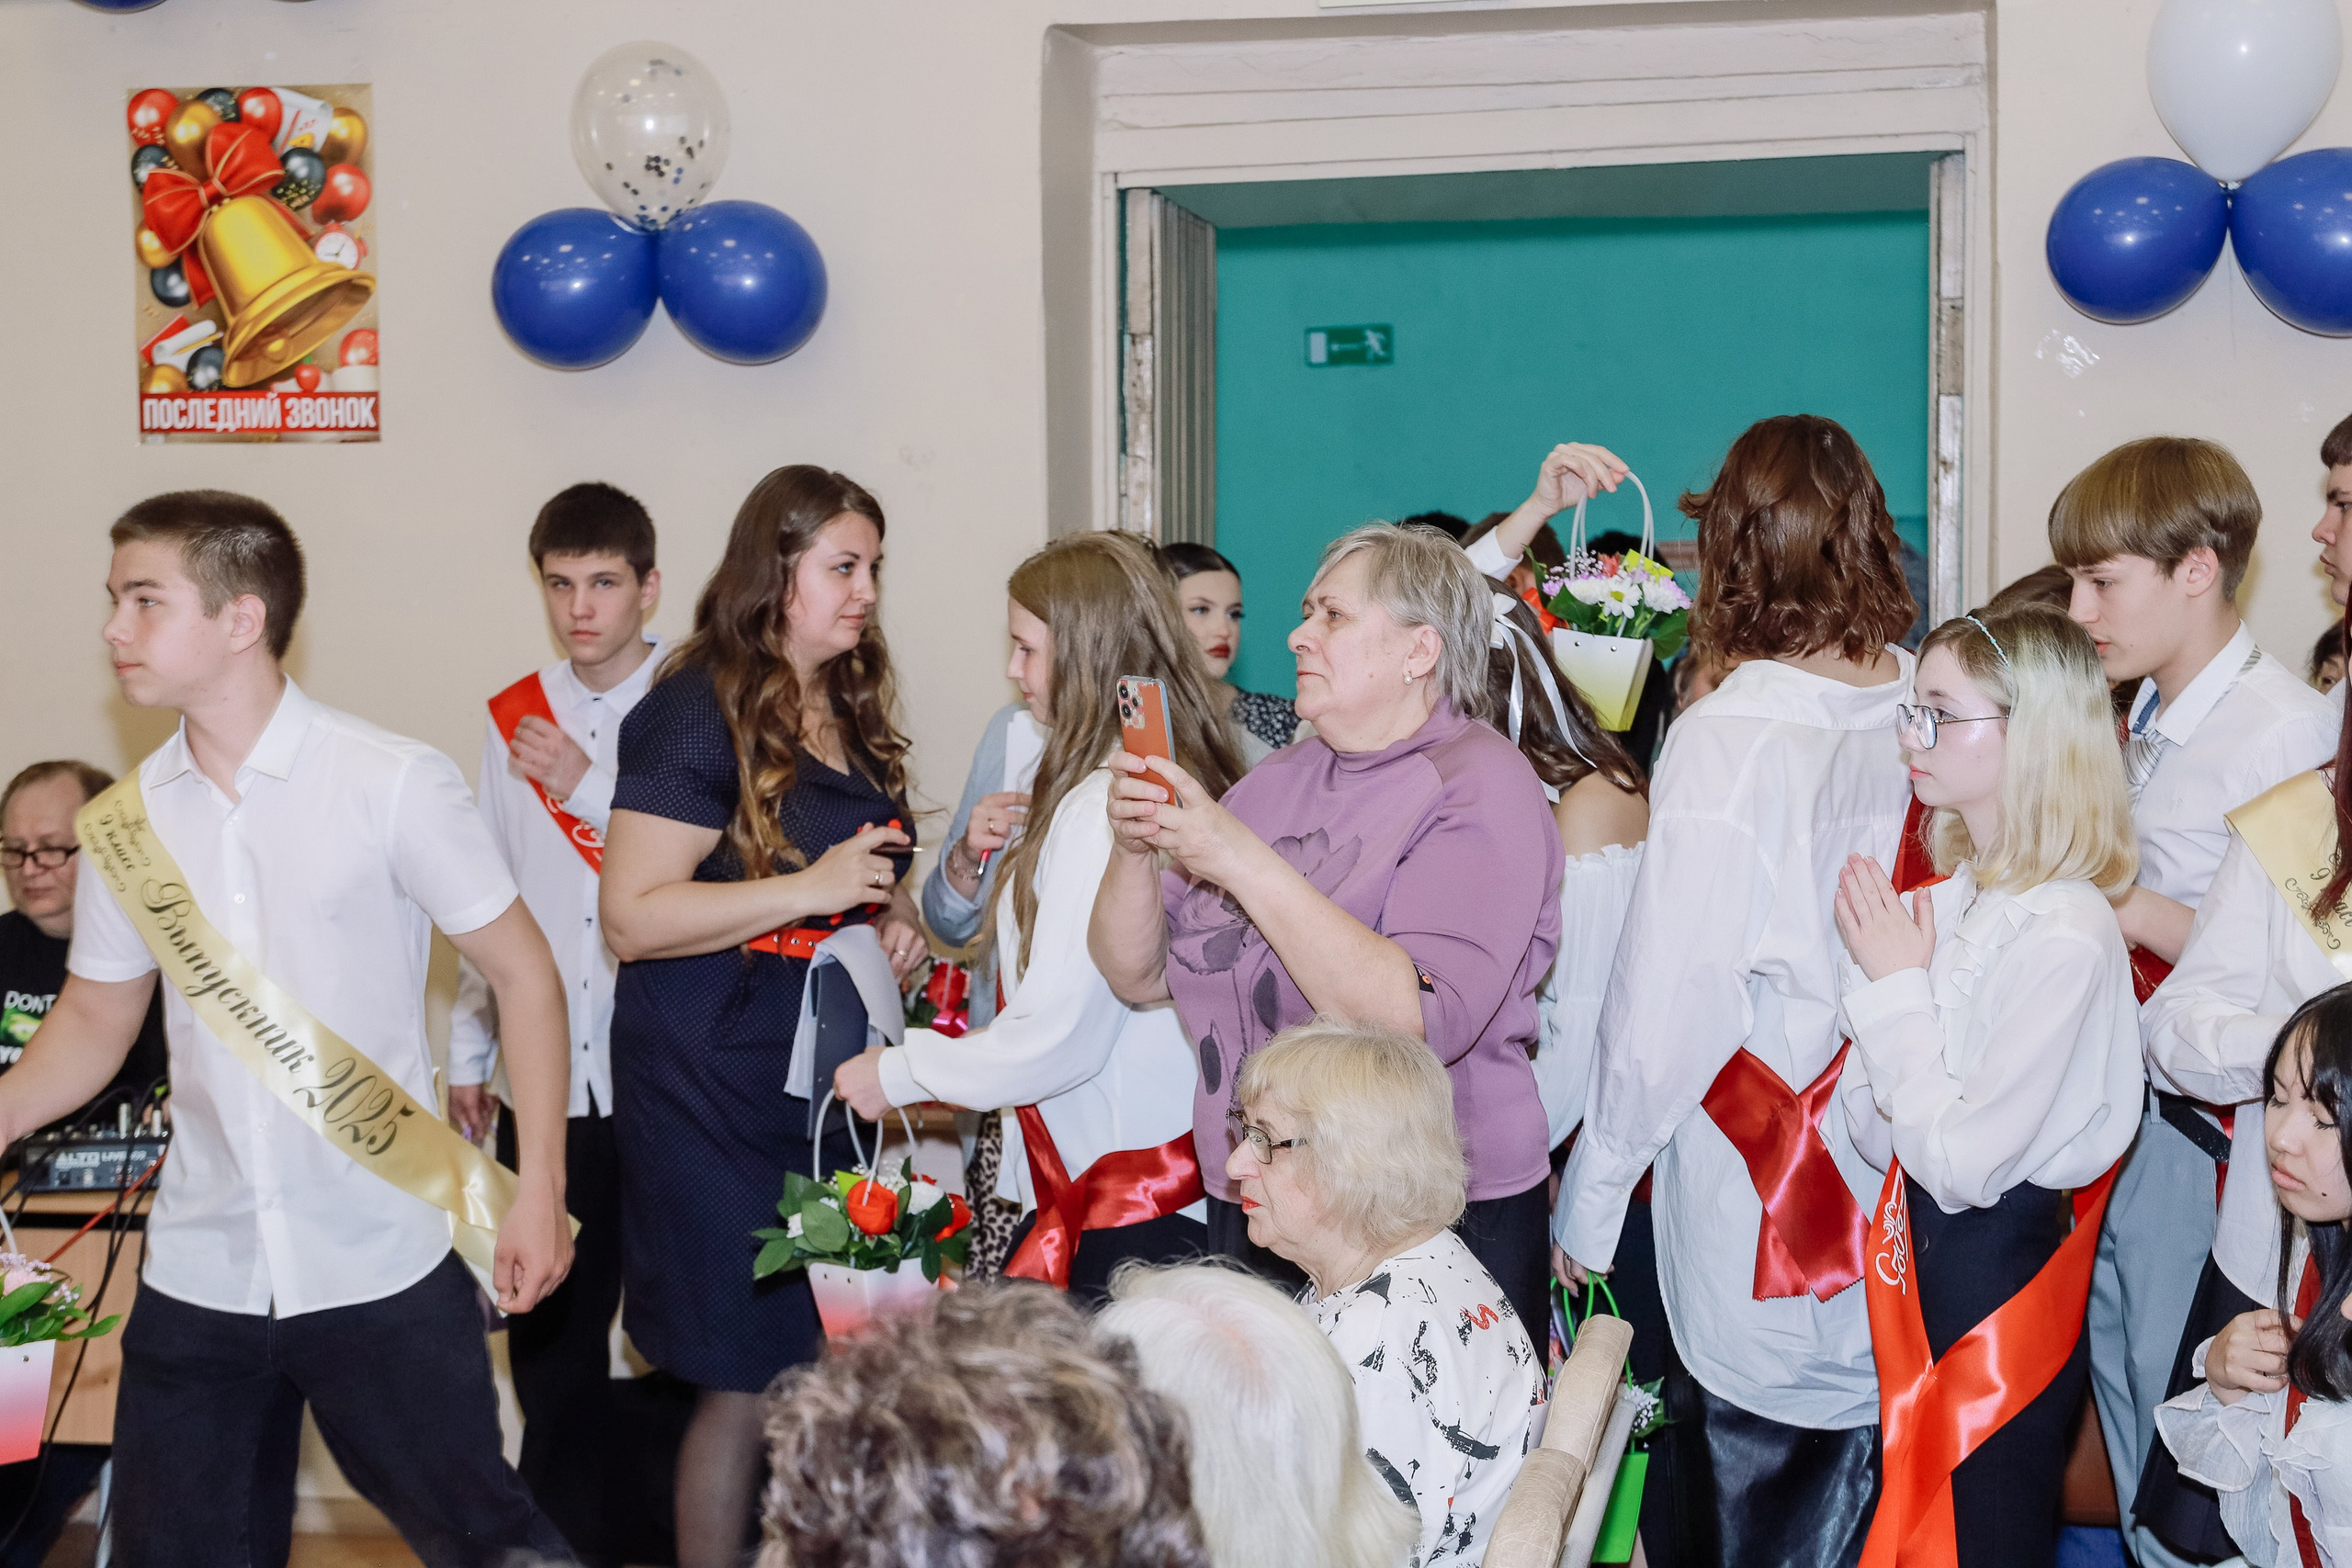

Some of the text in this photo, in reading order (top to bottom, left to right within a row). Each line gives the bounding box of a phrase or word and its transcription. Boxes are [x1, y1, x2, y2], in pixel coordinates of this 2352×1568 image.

[142, 392, 378, 433] ПОСЛЕДНИЙ ЗВОНОК
[99, 814, 135, 873] 9 класс
[2310, 867, 2331, 881] 9
[141, 877, 415, 1156] Выпускник 2025
